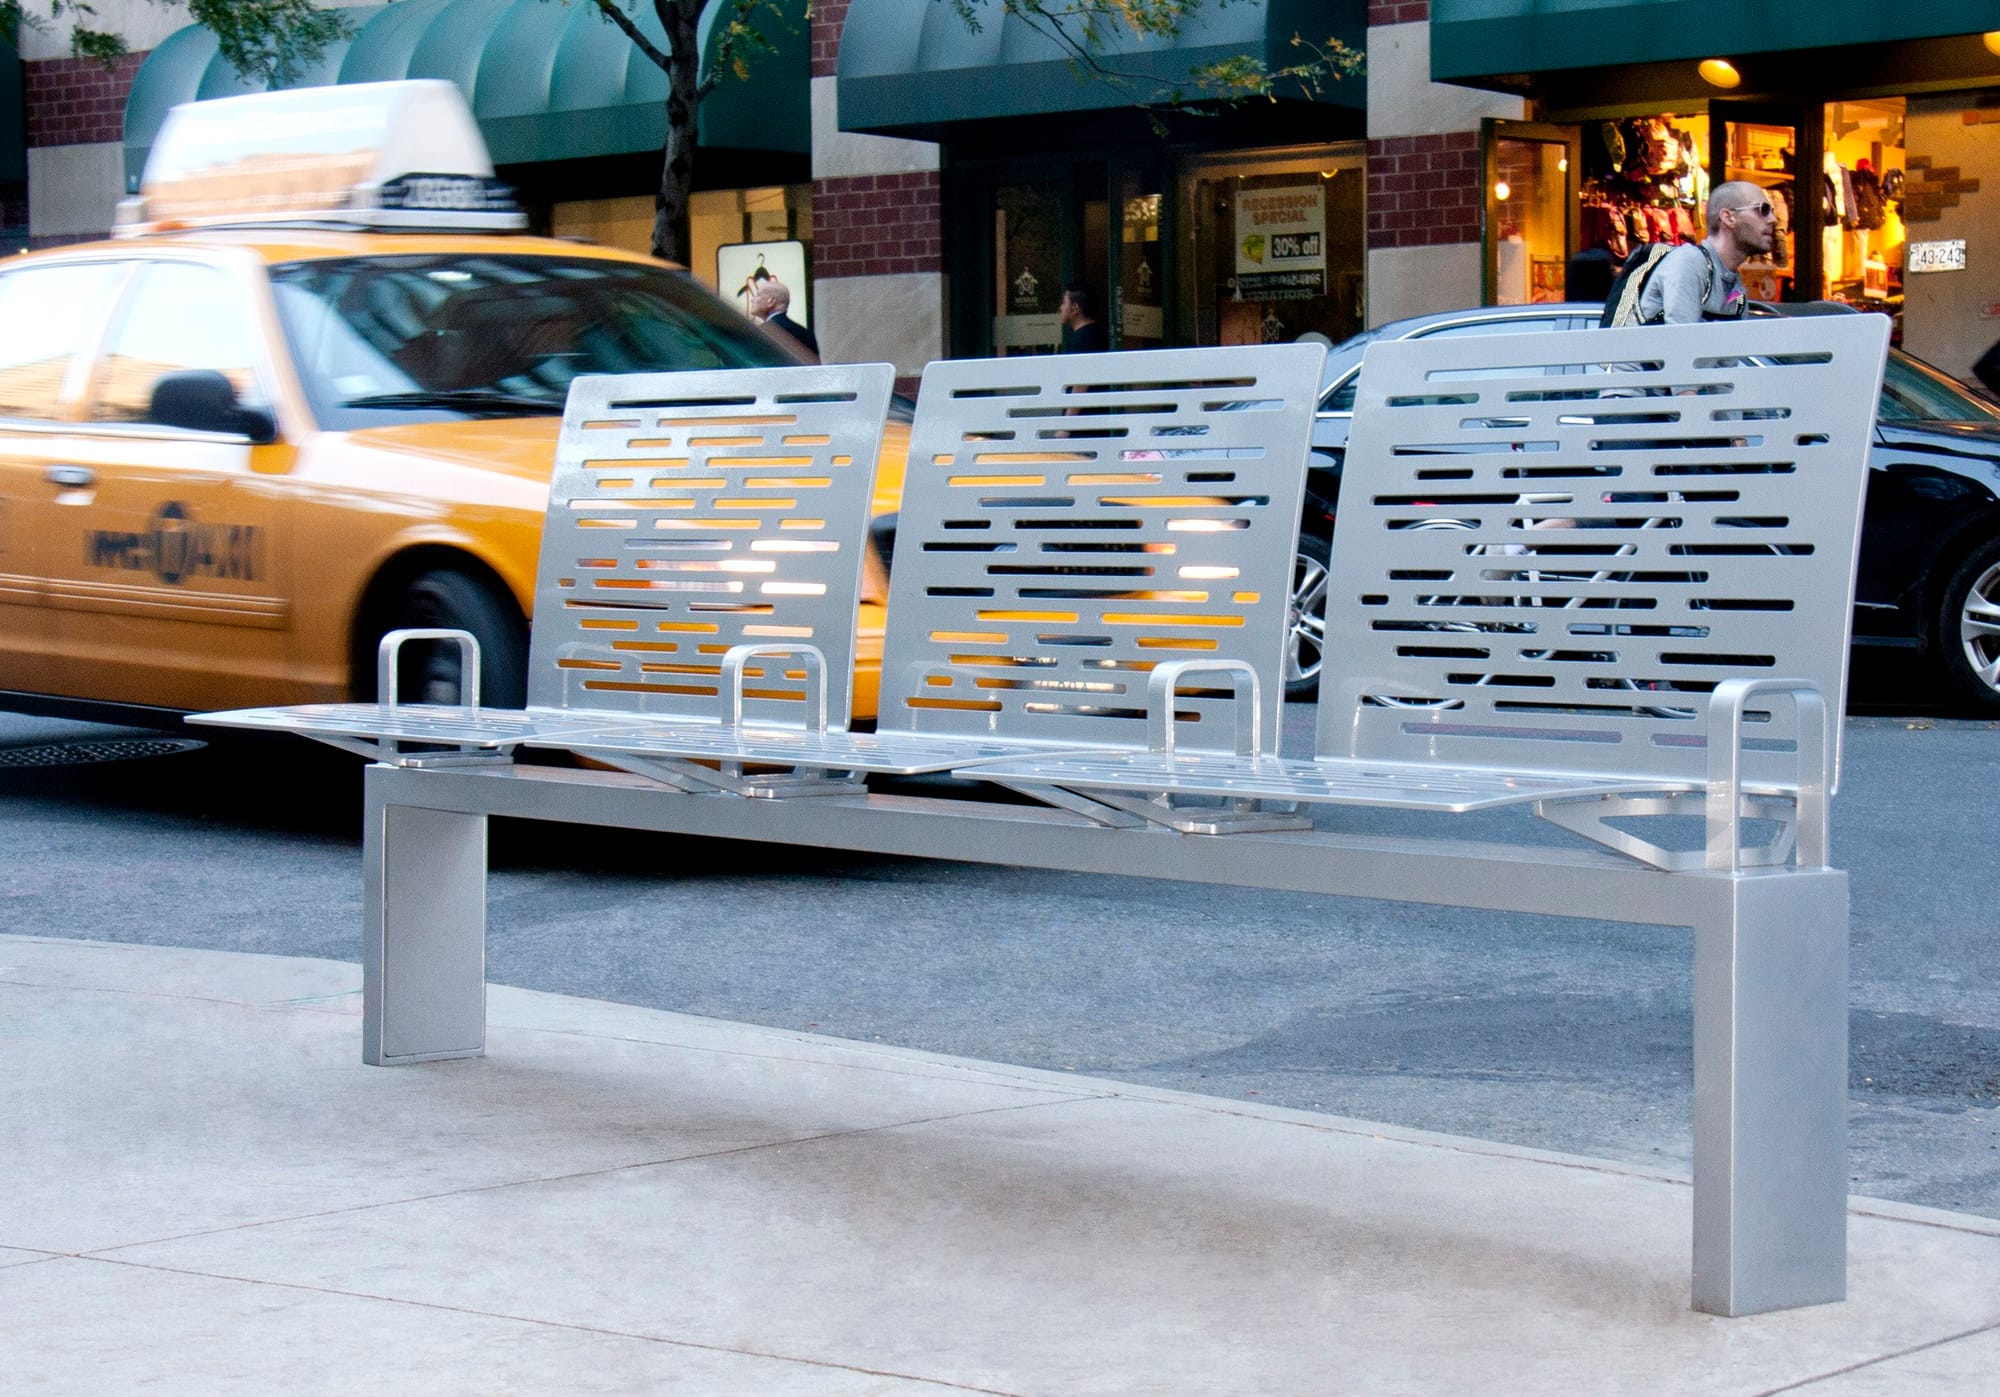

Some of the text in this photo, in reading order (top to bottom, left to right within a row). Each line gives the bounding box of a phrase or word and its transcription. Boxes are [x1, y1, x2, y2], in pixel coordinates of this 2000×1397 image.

[1242, 194, 1318, 211] RECESSION
[1253, 209, 1307, 225] SPECIAL
[1273, 235, 1319, 257] 30% off
[1920, 247, 1961, 265] 43-243
